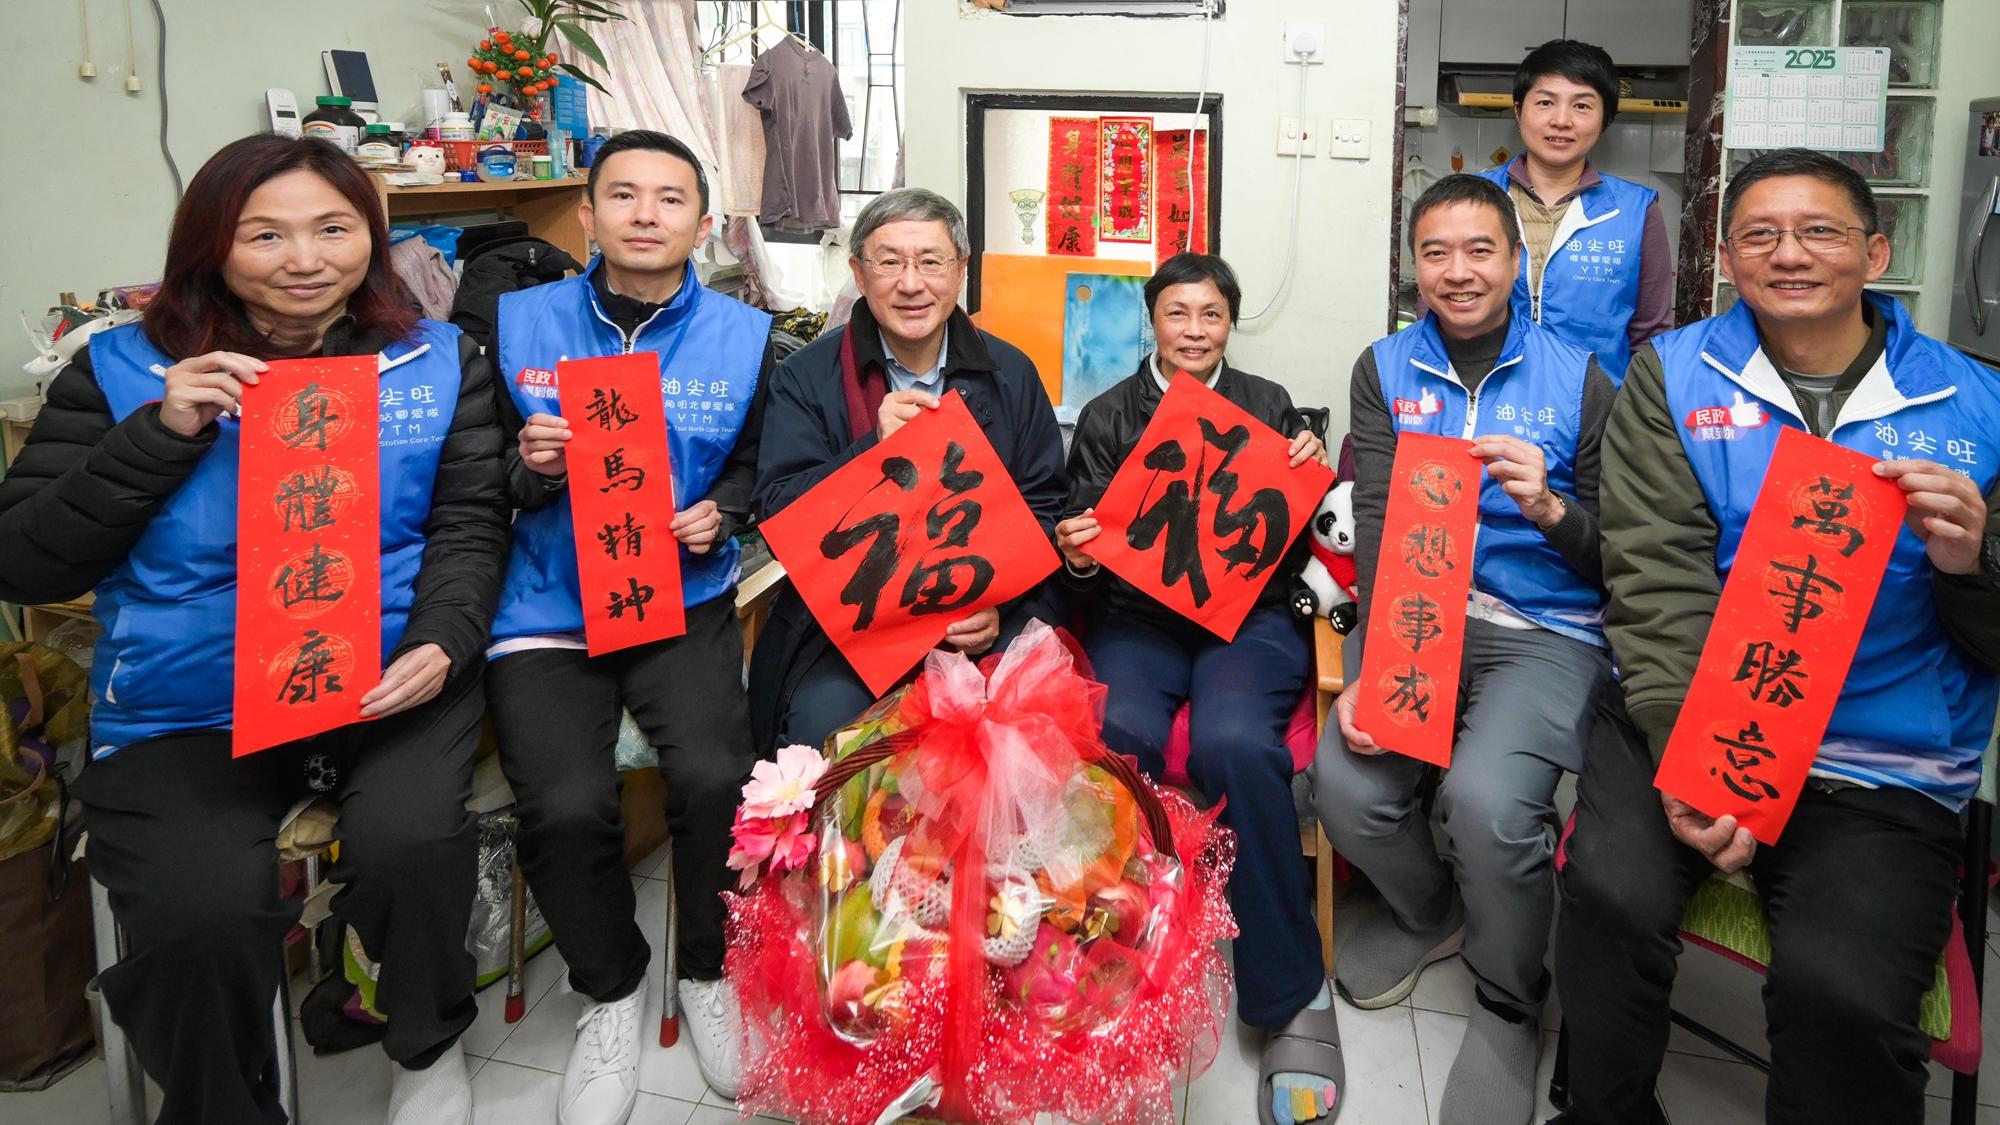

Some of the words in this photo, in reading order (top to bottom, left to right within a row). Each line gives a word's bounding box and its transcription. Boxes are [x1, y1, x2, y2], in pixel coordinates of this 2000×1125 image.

[1785, 49, 1836, 69] 2025
[1565, 238, 1625, 254] 油尖旺
[1581, 265, 1613, 275] YTM
[523, 368, 553, 385] 民政
[661, 377, 729, 398] 油尖旺
[678, 413, 712, 424] YTM
[1496, 403, 1556, 425] 油尖旺
[1695, 407, 1726, 426] 民政
[688, 425, 704, 433] North
[379, 439, 408, 447] Station
[1873, 420, 1977, 465] 油尖旺
[585, 388, 655, 622] 龍馬精神
[1126, 416, 1291, 609] 福
[273, 383, 345, 704] 身體健康
[819, 441, 995, 632] 福
[1384, 468, 1463, 724] 心想事成
[1709, 476, 1866, 803] 萬事勝意
